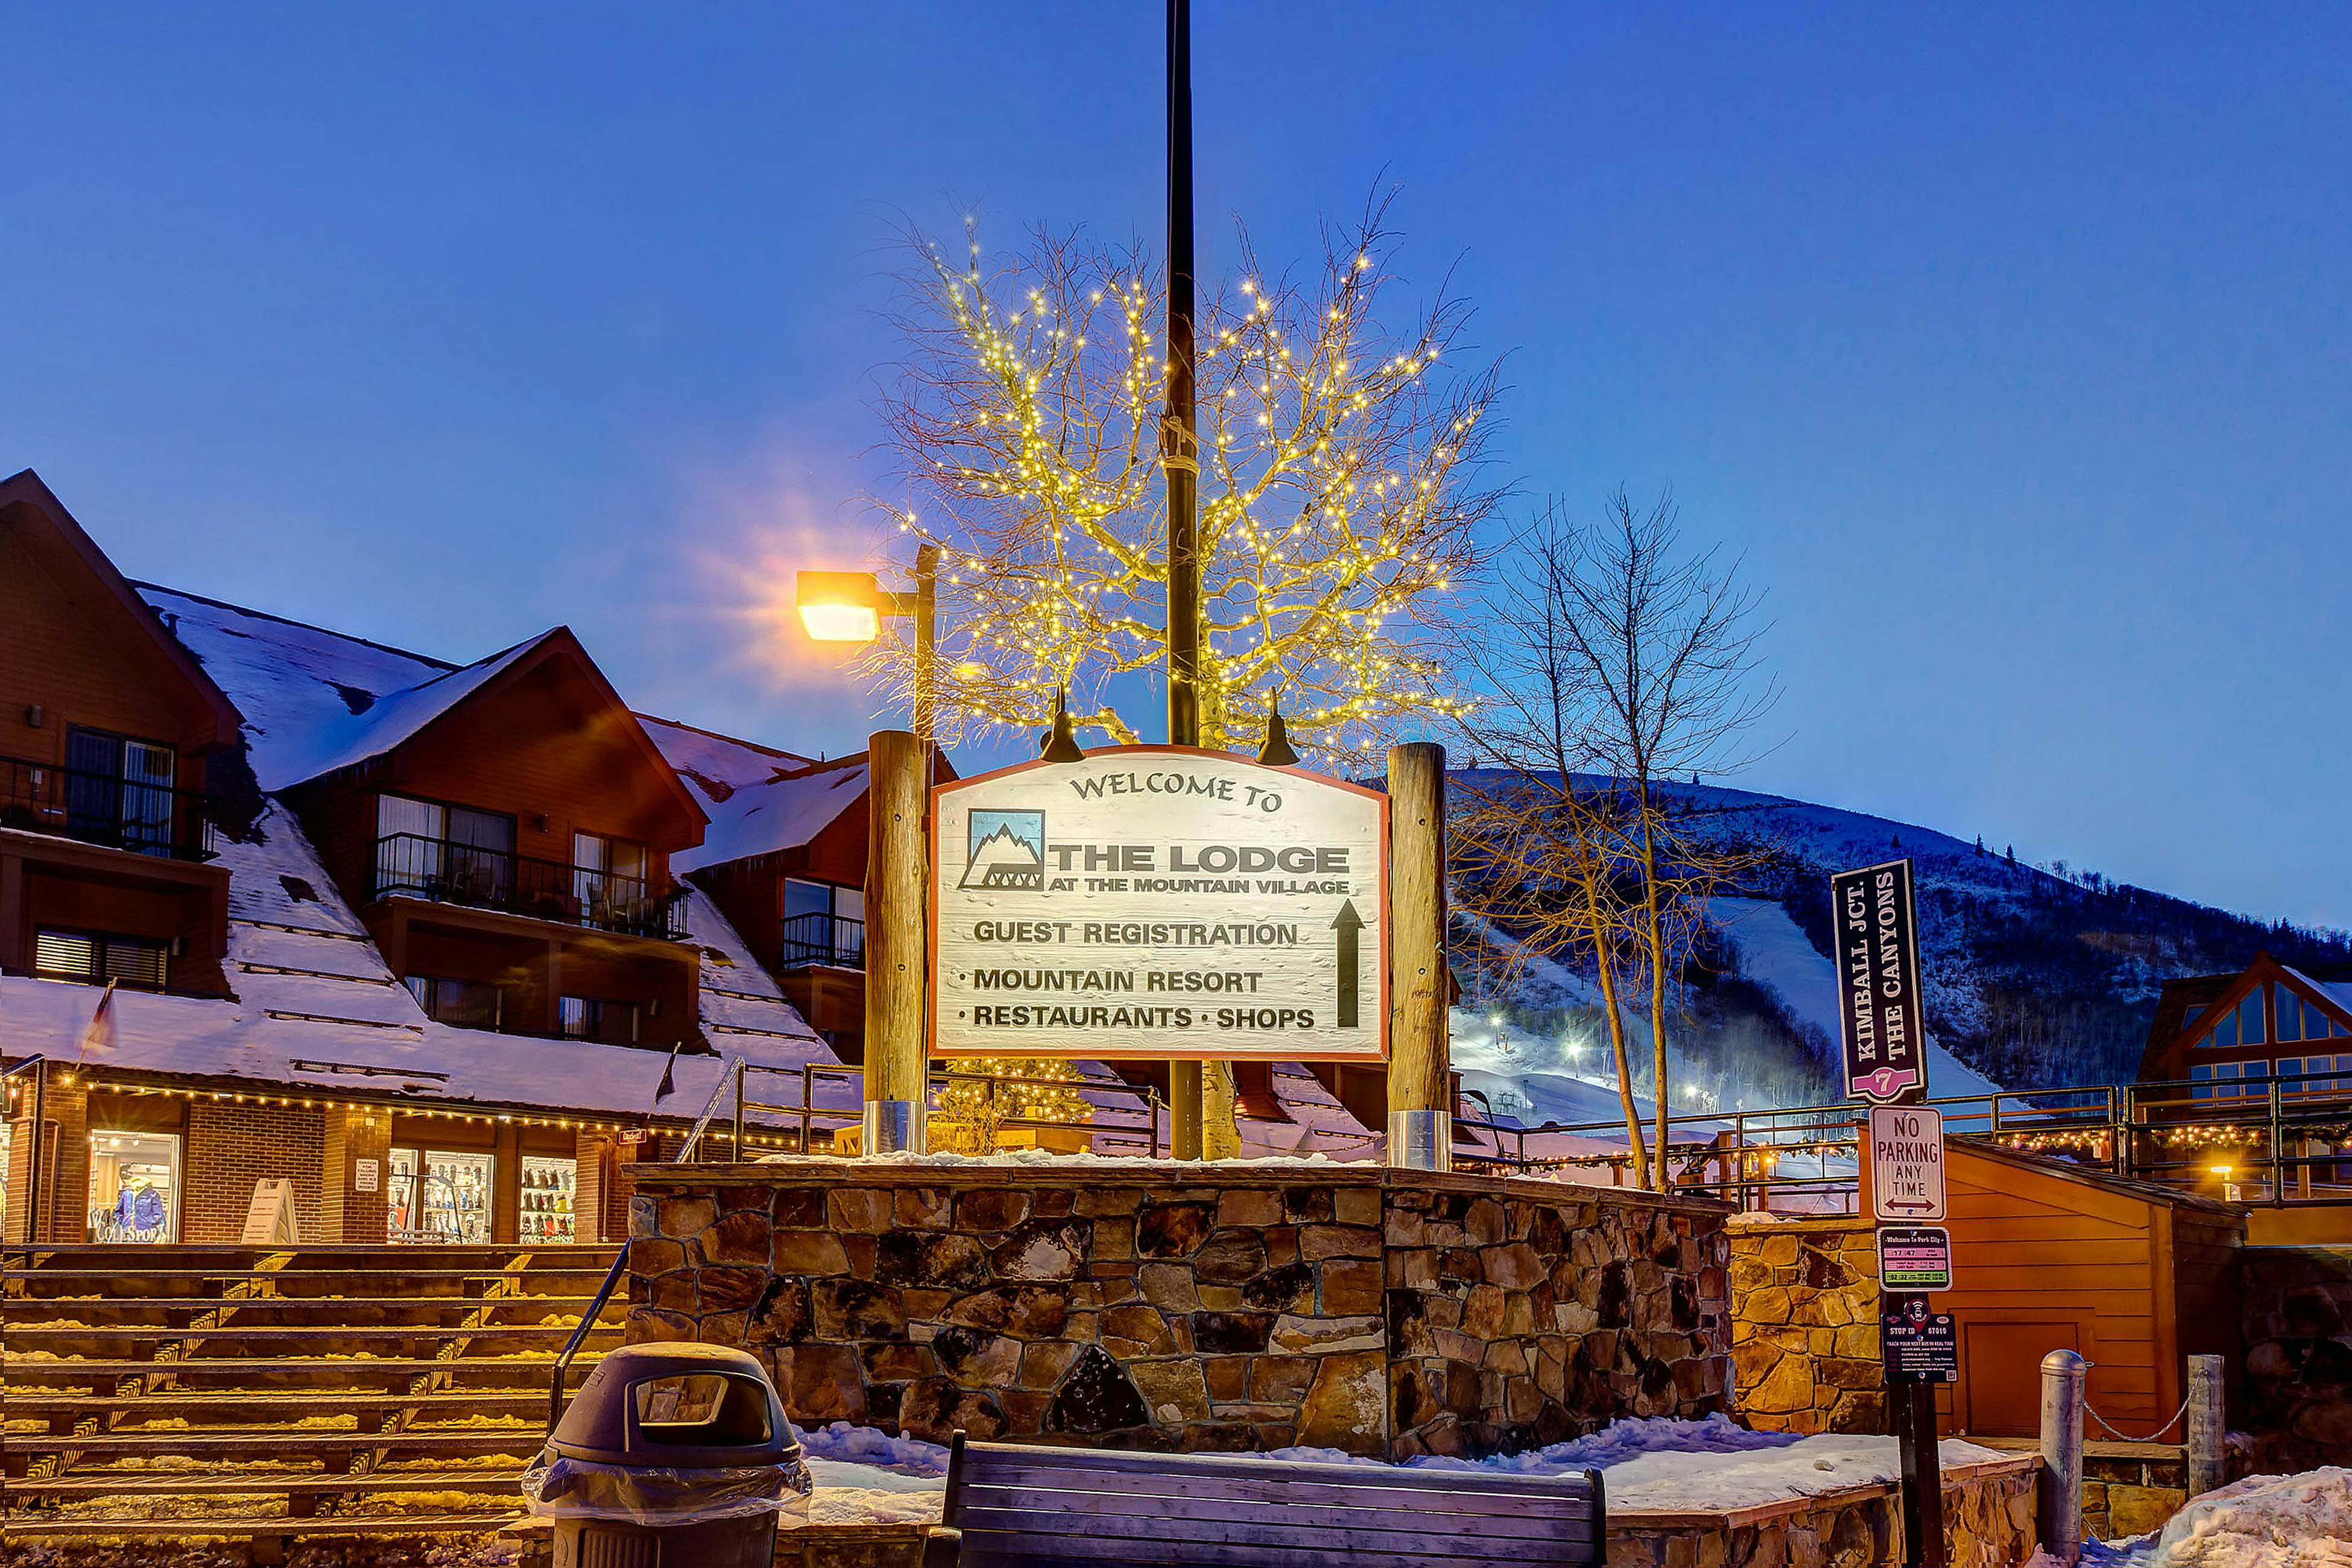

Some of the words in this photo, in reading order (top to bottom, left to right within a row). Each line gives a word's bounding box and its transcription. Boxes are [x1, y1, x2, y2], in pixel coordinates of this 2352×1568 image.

[1070, 771, 1234, 801] WELCOME
[1245, 786, 1283, 814] TO
[1049, 844, 1155, 872] THE
[1170, 846, 1350, 874] LODGE
[1049, 879, 1080, 891] AT
[1085, 879, 1128, 892] THE
[1134, 879, 1250, 893] MOUNTAIN
[1257, 880, 1350, 895] VILLAGE
[1847, 880, 1868, 933] JCT.
[973, 921, 1072, 943] GUEST
[1084, 922, 1298, 945] REGISTRATION
[1876, 872, 1901, 997] CANYONS
[973, 969, 1134, 991] MOUNTAIN
[1147, 970, 1263, 993] RESORT
[1851, 939, 1876, 1061] KIMBALL
[973, 1005, 1192, 1028] RESTAURANTS
[1217, 1008, 1314, 1028] SHOPS
[1885, 1005, 1906, 1061] THE
[1875, 1073, 1892, 1093] 7
[1893, 1116, 1920, 1139] NO
[1878, 1142, 1939, 1164] PARKING
[1896, 1165, 1922, 1180] ANY
[1892, 1181, 1926, 1197] TIME
